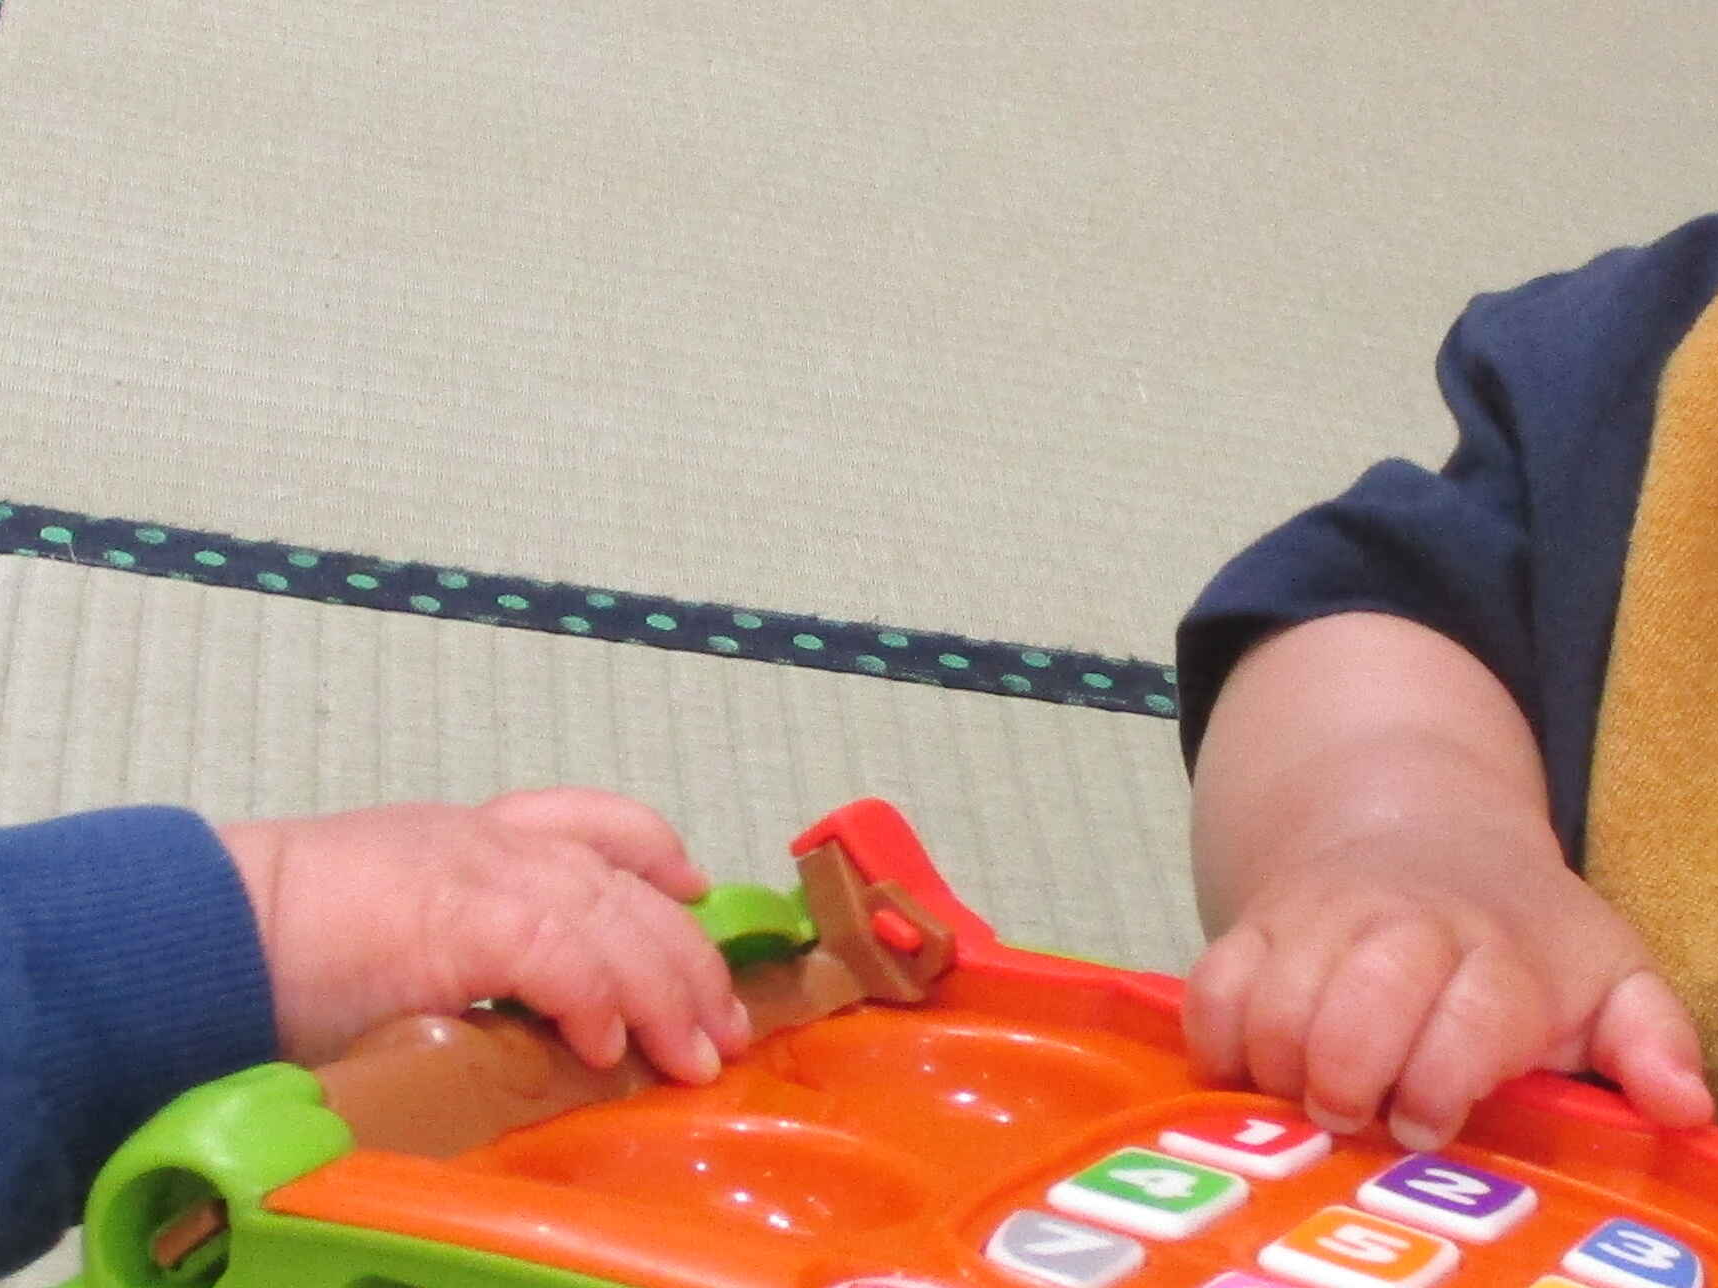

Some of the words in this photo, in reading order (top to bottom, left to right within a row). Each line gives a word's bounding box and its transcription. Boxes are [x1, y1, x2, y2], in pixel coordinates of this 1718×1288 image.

[1234, 1118, 1286, 1146] 1
[1107, 1168, 1200, 1199] 4
[1404, 1167, 1491, 1206] 2
[1023, 1220, 1114, 1256] 7
[1316, 1223, 1413, 1264] 5
[1596, 1228, 1681, 1271] 3
